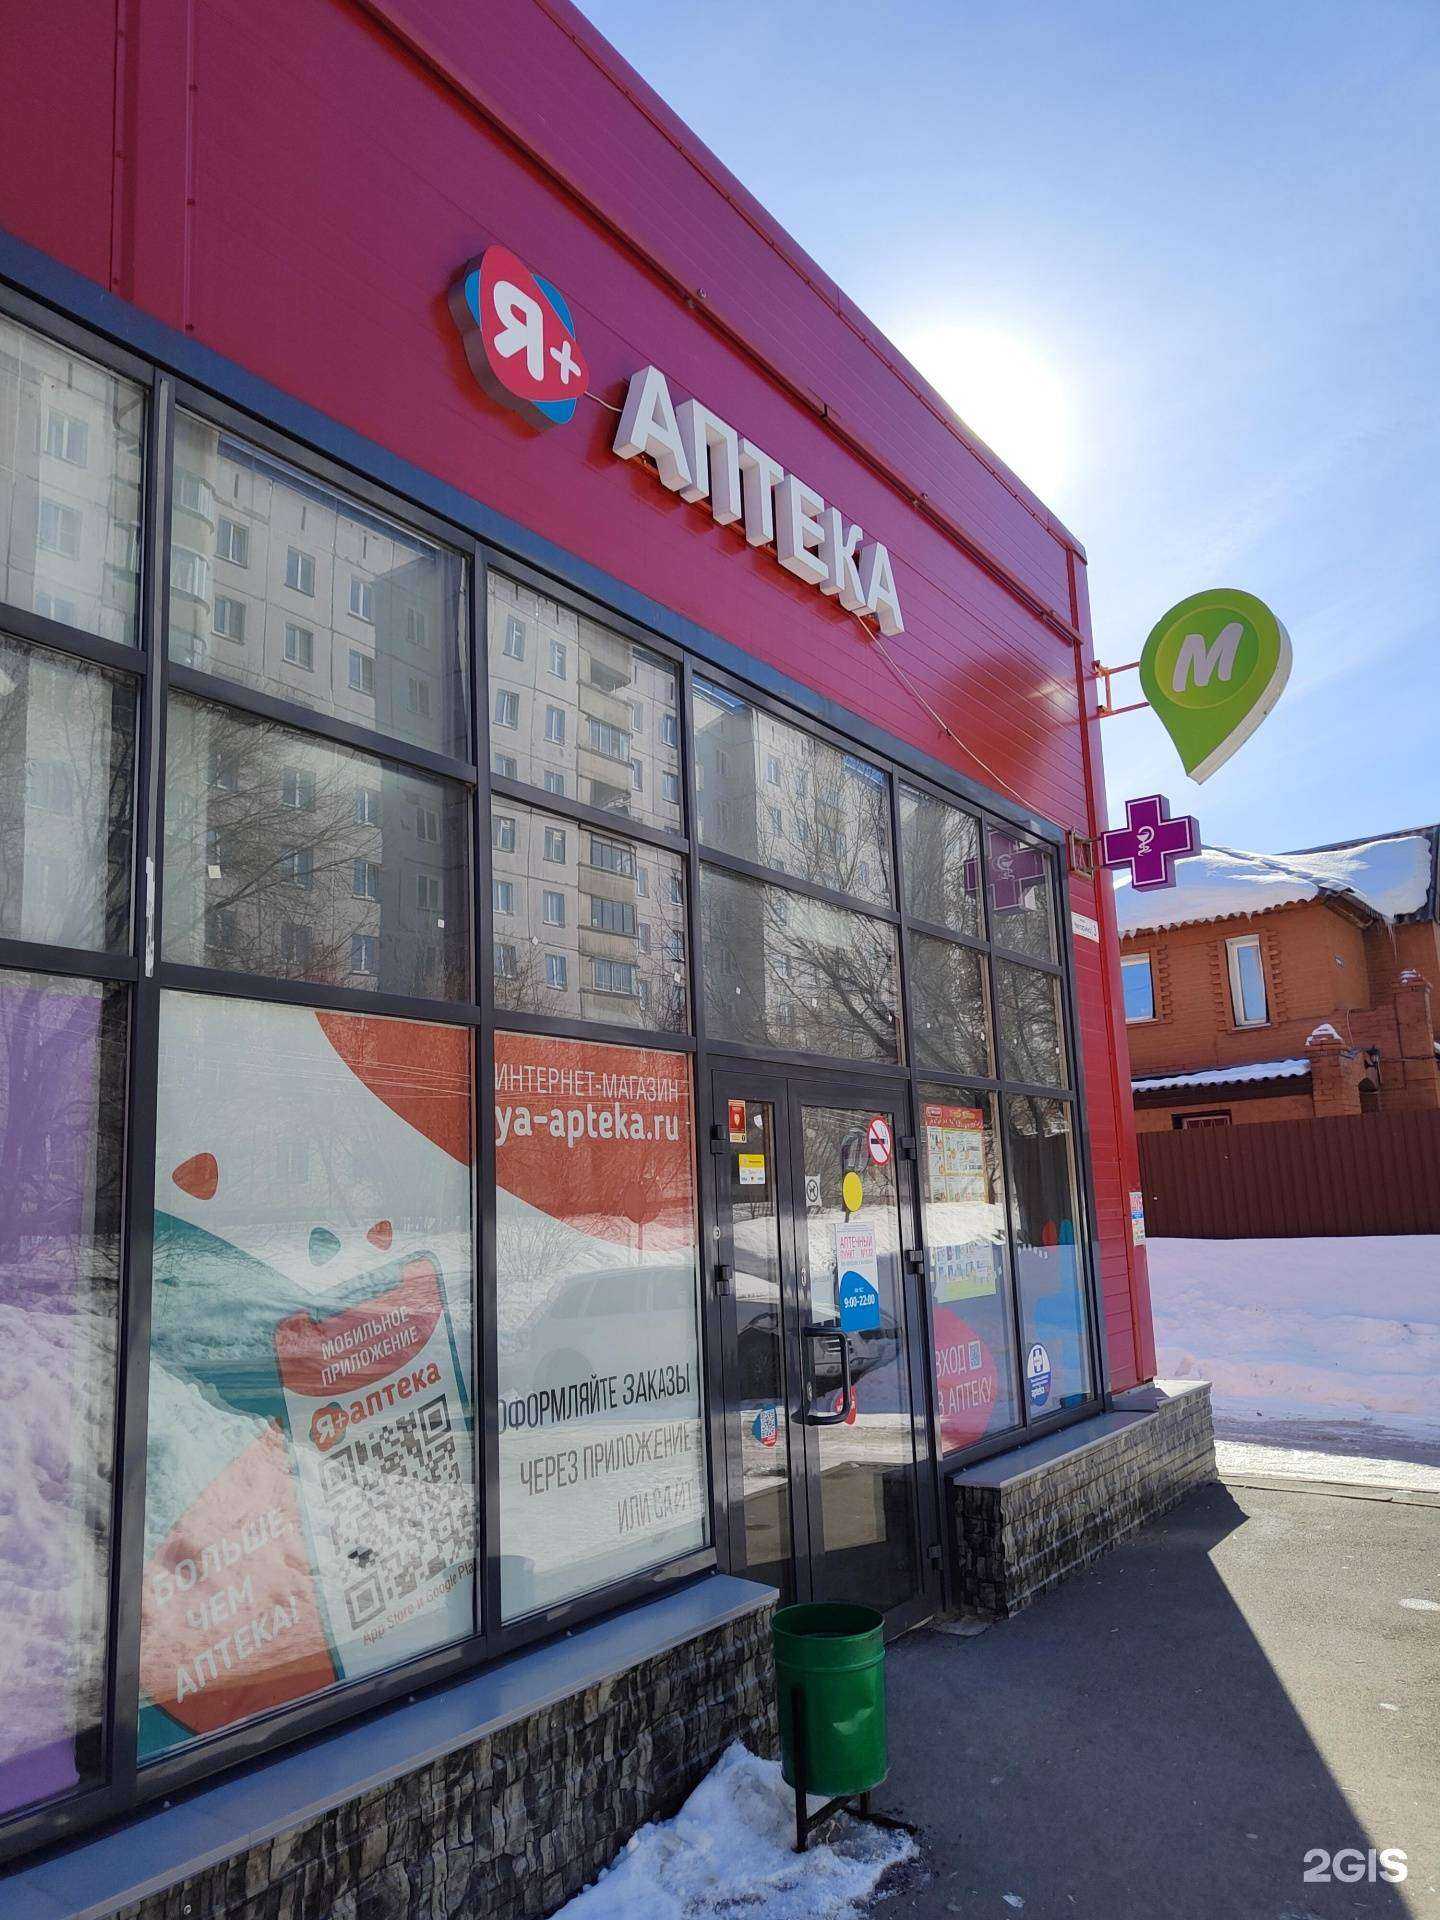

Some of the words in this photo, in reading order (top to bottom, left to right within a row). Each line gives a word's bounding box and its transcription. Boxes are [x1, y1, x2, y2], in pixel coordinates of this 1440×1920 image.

[612, 364, 905, 637] АПТЕКА
[494, 1063, 679, 1103] ИНТЕРНЕТ-МАГАЗИН
[494, 1101, 680, 1149] ya-apteka.ru
[320, 1326, 419, 1387] ПРИЛОЖЕНИЕ
[321, 1306, 410, 1361] МОБИЛЬНОЕ
[936, 1343, 968, 1377] ВХОД
[622, 1362, 691, 1406] ЗАКАЗЫ
[949, 1375, 992, 1415] АПТЕКУ
[520, 1449, 579, 1497] ЧЕРЕЗ
[583, 1421, 692, 1481] ПРИЛОЖЕНИЕ
[186, 1574, 254, 1631] ЧЕМ
[363, 1625, 386, 1647] App
[386, 1603, 414, 1627] Store
[425, 1573, 458, 1602] Google
[176, 1594, 299, 1704] АПТЕКА!
